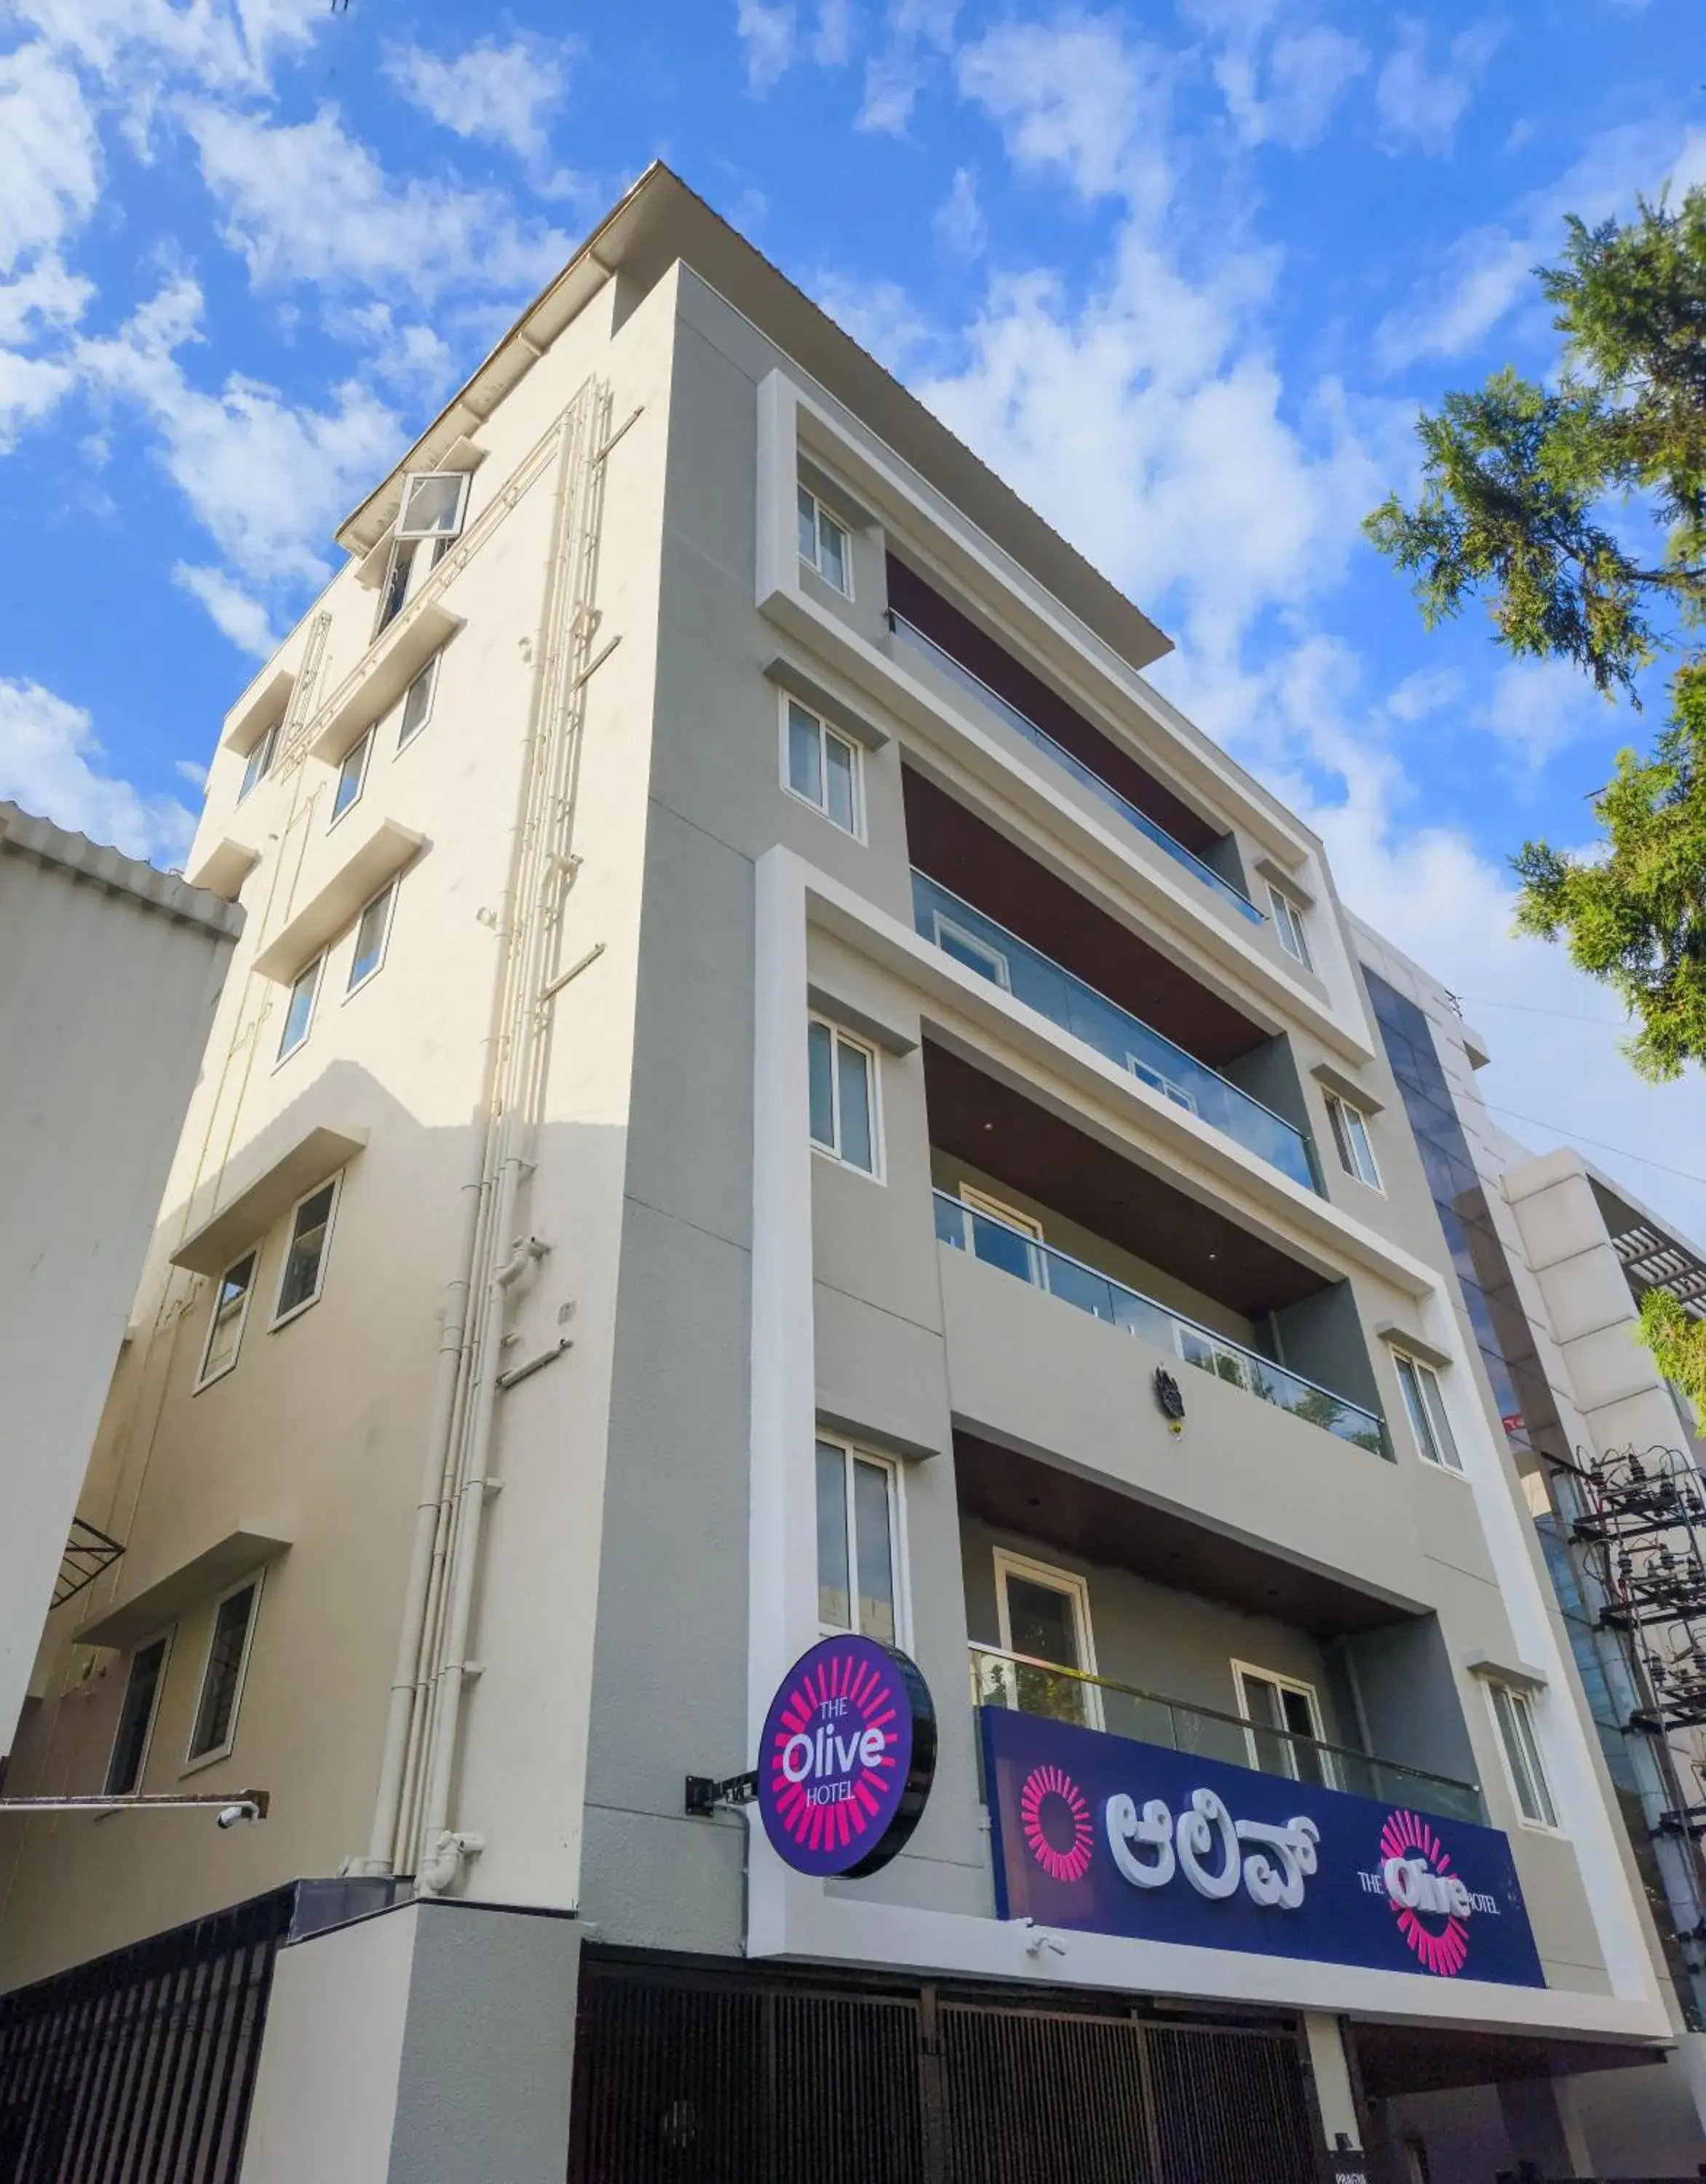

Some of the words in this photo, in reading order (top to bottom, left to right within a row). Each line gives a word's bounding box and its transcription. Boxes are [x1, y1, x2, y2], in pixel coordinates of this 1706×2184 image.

[820, 1697, 848, 1719] THE
[782, 1723, 886, 1782] Olive
[806, 1780, 855, 1808] HOTEL
[1357, 1872, 1385, 1894] THE
